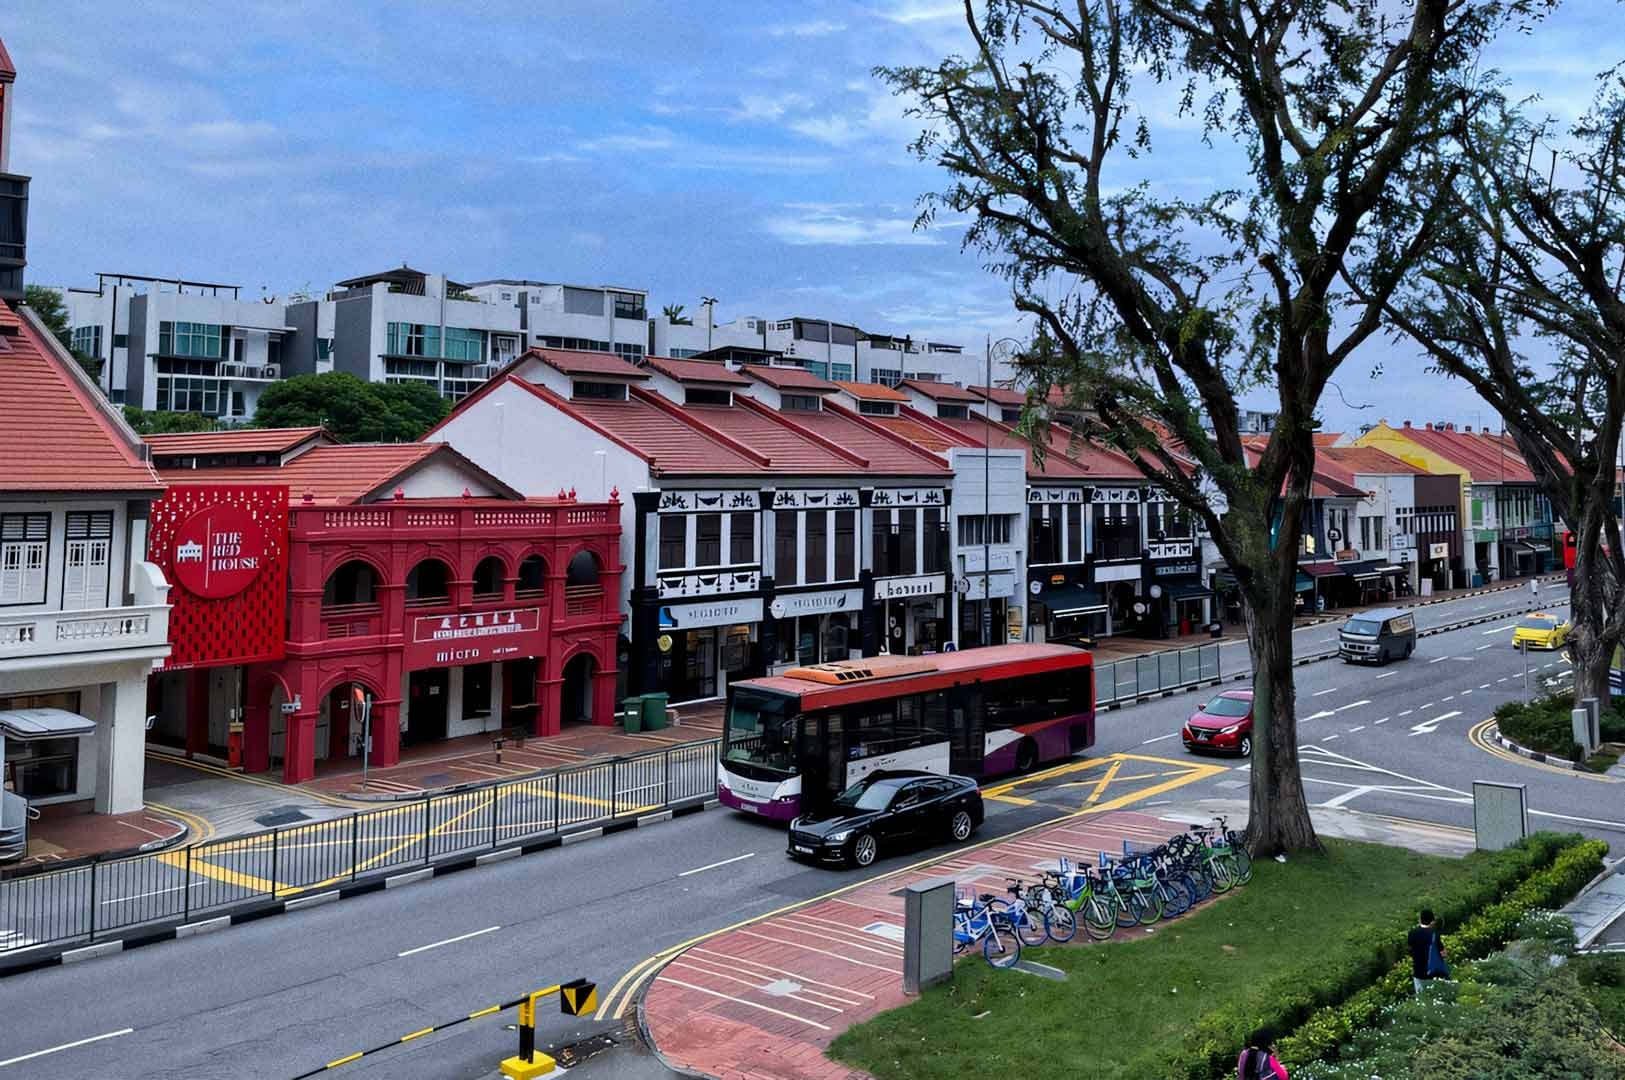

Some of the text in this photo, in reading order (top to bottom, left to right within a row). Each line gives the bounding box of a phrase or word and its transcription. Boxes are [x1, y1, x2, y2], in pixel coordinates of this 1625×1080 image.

[212, 532, 242, 544] THE
[212, 544, 241, 557] RED
[212, 557, 260, 571] HOUSE
[436, 647, 480, 662] micro
